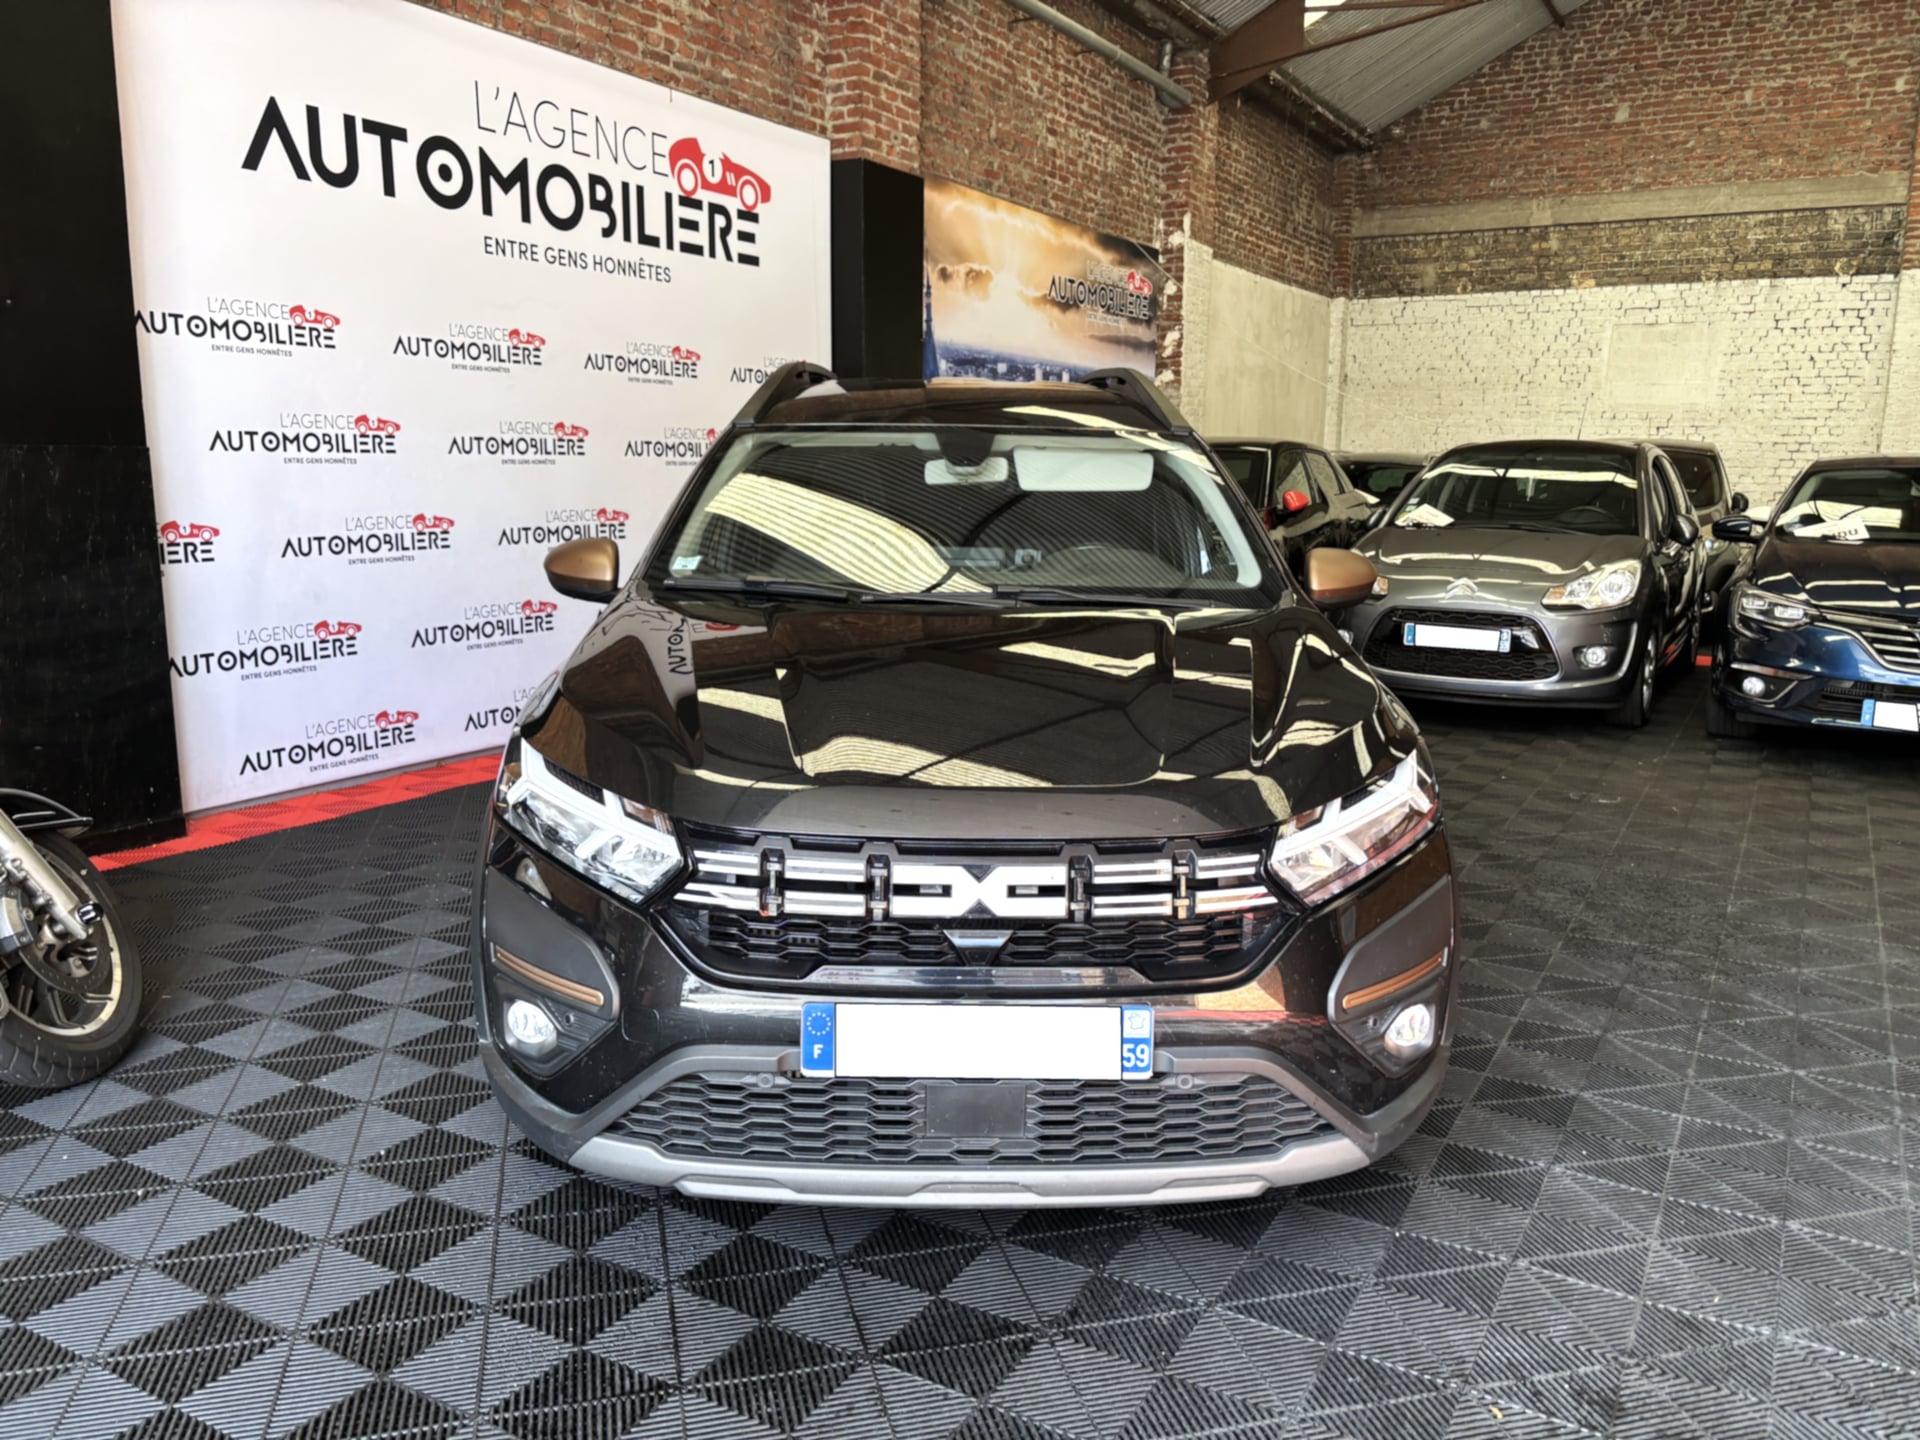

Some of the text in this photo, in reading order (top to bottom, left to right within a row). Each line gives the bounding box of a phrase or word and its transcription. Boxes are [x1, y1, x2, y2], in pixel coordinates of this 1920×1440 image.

[475, 80, 669, 178] L'AGENCE
[707, 158, 716, 178] 1
[241, 96, 760, 268] AUTOMOBILIERE
[484, 236, 672, 284] ENTRE GENS HONNÊTES
[207, 296, 291, 320] L'AGENCE
[449, 323, 509, 342] L'AGENCE
[211, 344, 234, 353] ENTRE
[236, 346, 255, 354] GENS
[626, 341, 673, 358] L'AGENCE
[280, 413, 354, 430] L'AGENCE
[500, 421, 554, 436] L'AGENCE
[624, 440, 713, 458] AUTOMOBIL
[305, 457, 323, 465] GENS
[345, 514, 413, 532] L'AGENCE
[545, 508, 597, 523] L'AGENCE
[464, 602, 521, 620] L'AGENCE
[237, 622, 314, 646] L'AGENCE
[241, 672, 262, 681] ENTRE
[264, 670, 282, 679] GENS
[305, 713, 376, 739] L'AGENCE
[812, 1044, 823, 1059] F
[1122, 1043, 1150, 1068] 59
